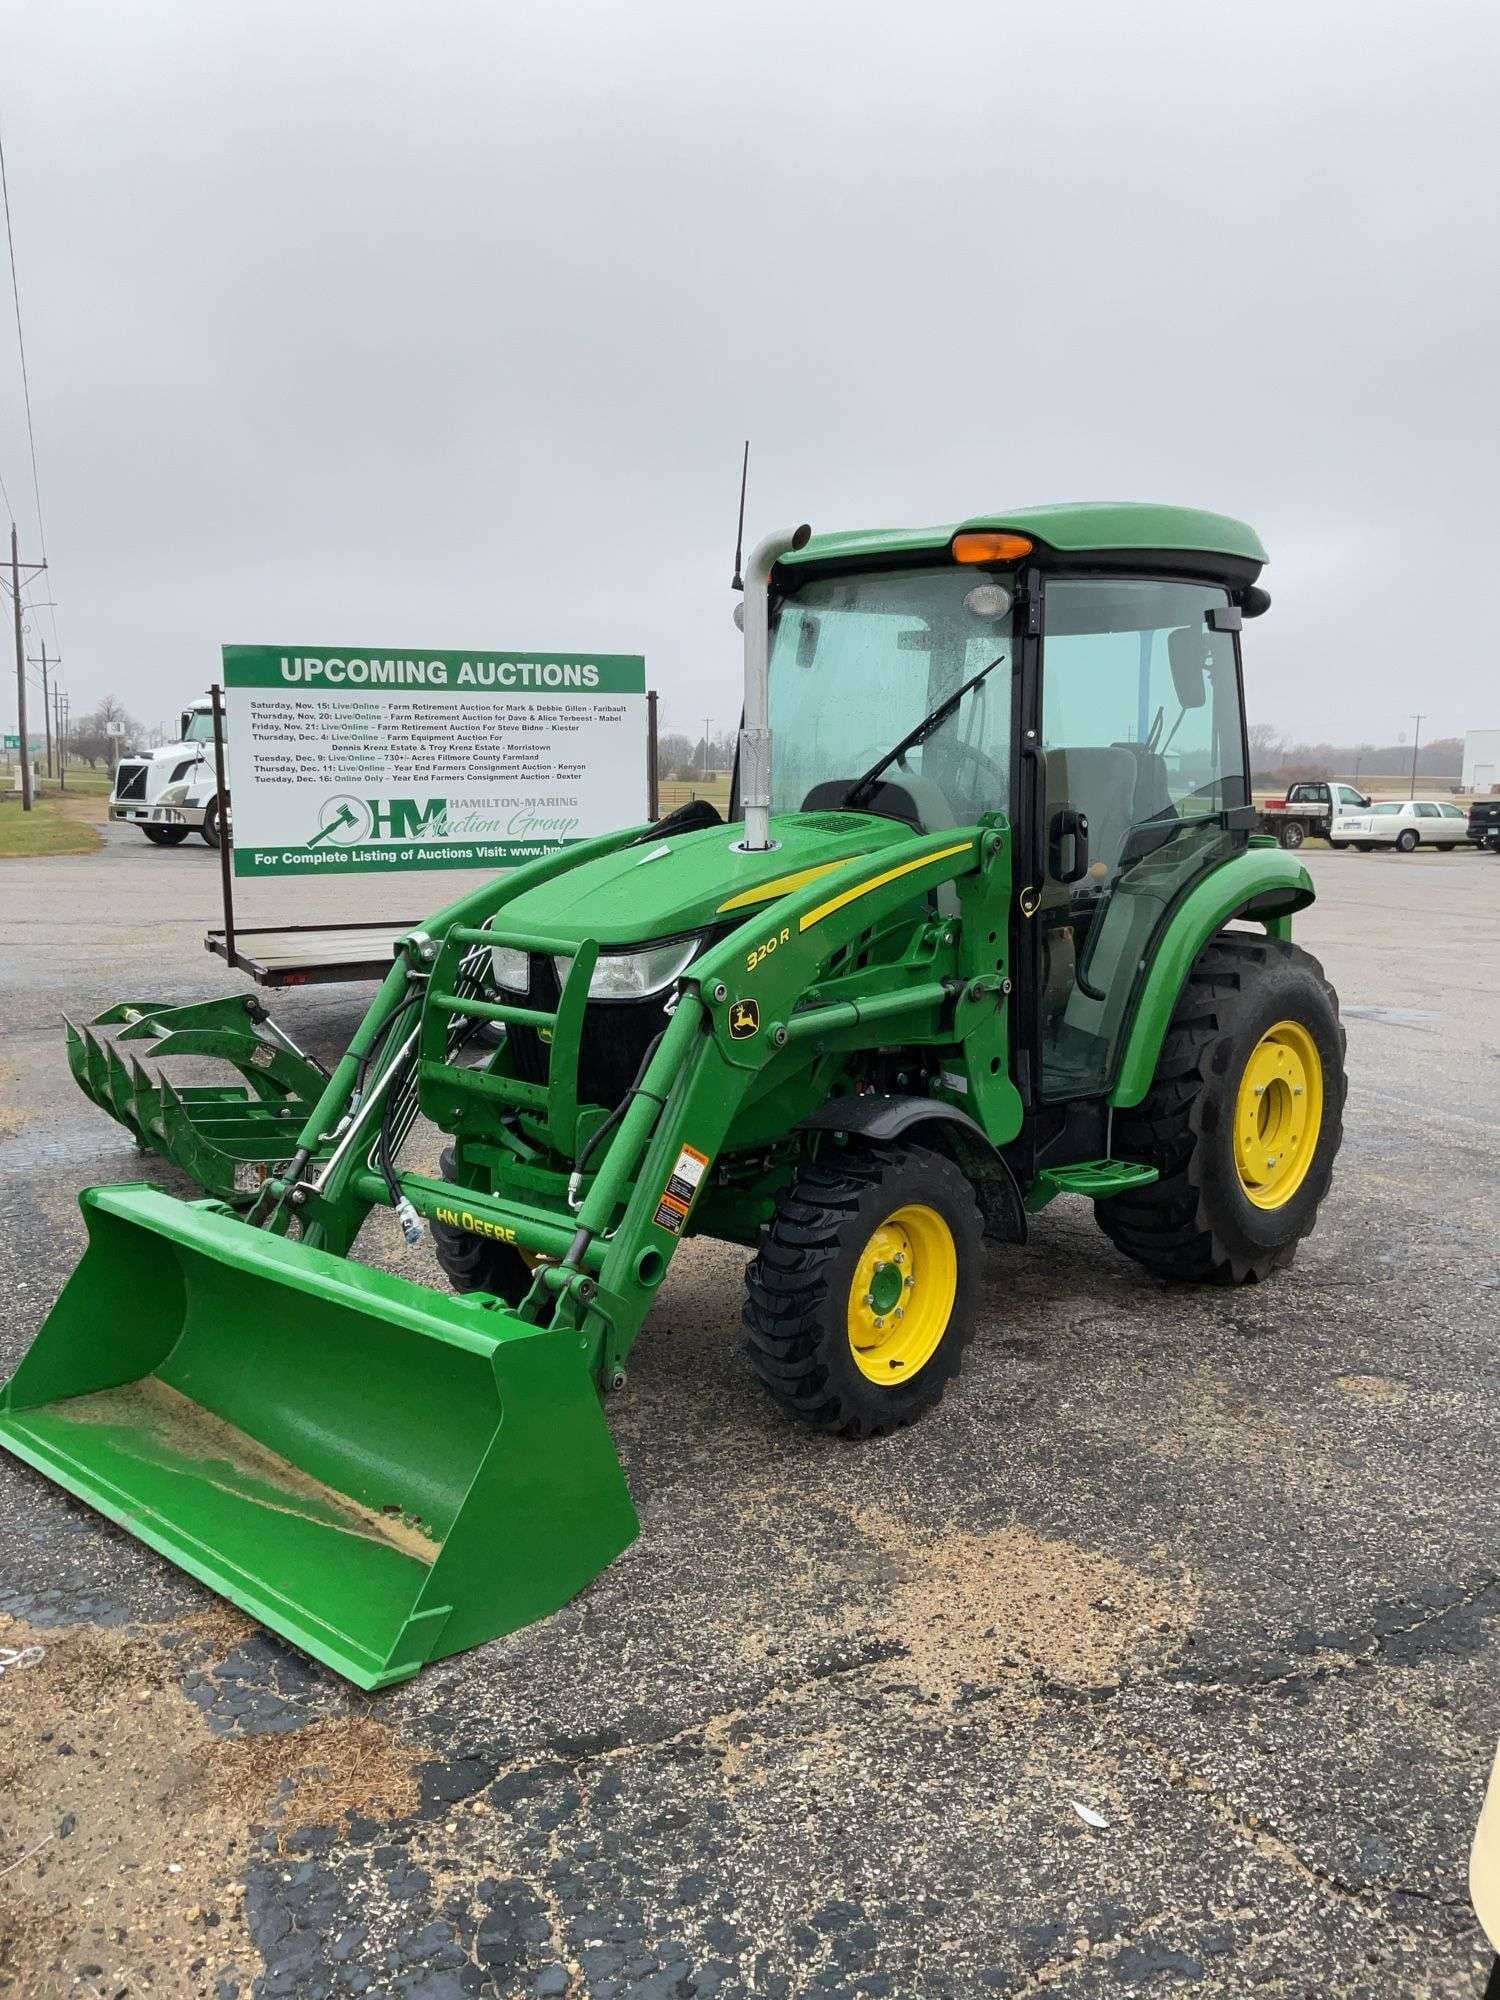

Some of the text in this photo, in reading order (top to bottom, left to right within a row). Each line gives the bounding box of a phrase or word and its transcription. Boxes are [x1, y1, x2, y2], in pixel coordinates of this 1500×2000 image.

[281, 657, 600, 687] UPCOMING AUCTIONS
[251, 702, 293, 710] Saturday,
[251, 713, 294, 721] Thursday,
[253, 734, 296, 742] Thursday,
[468, 764, 520, 772] Consignment
[450, 797, 578, 808] HAMILTON-MARING
[366, 799, 448, 838] HM
[410, 808, 580, 844] Auction Group
[255, 845, 562, 864] For Complete Listing of Auctions Visit: www.hm
[746, 928, 790, 972] 320 R
[462, 1212, 516, 1241] DEERE
